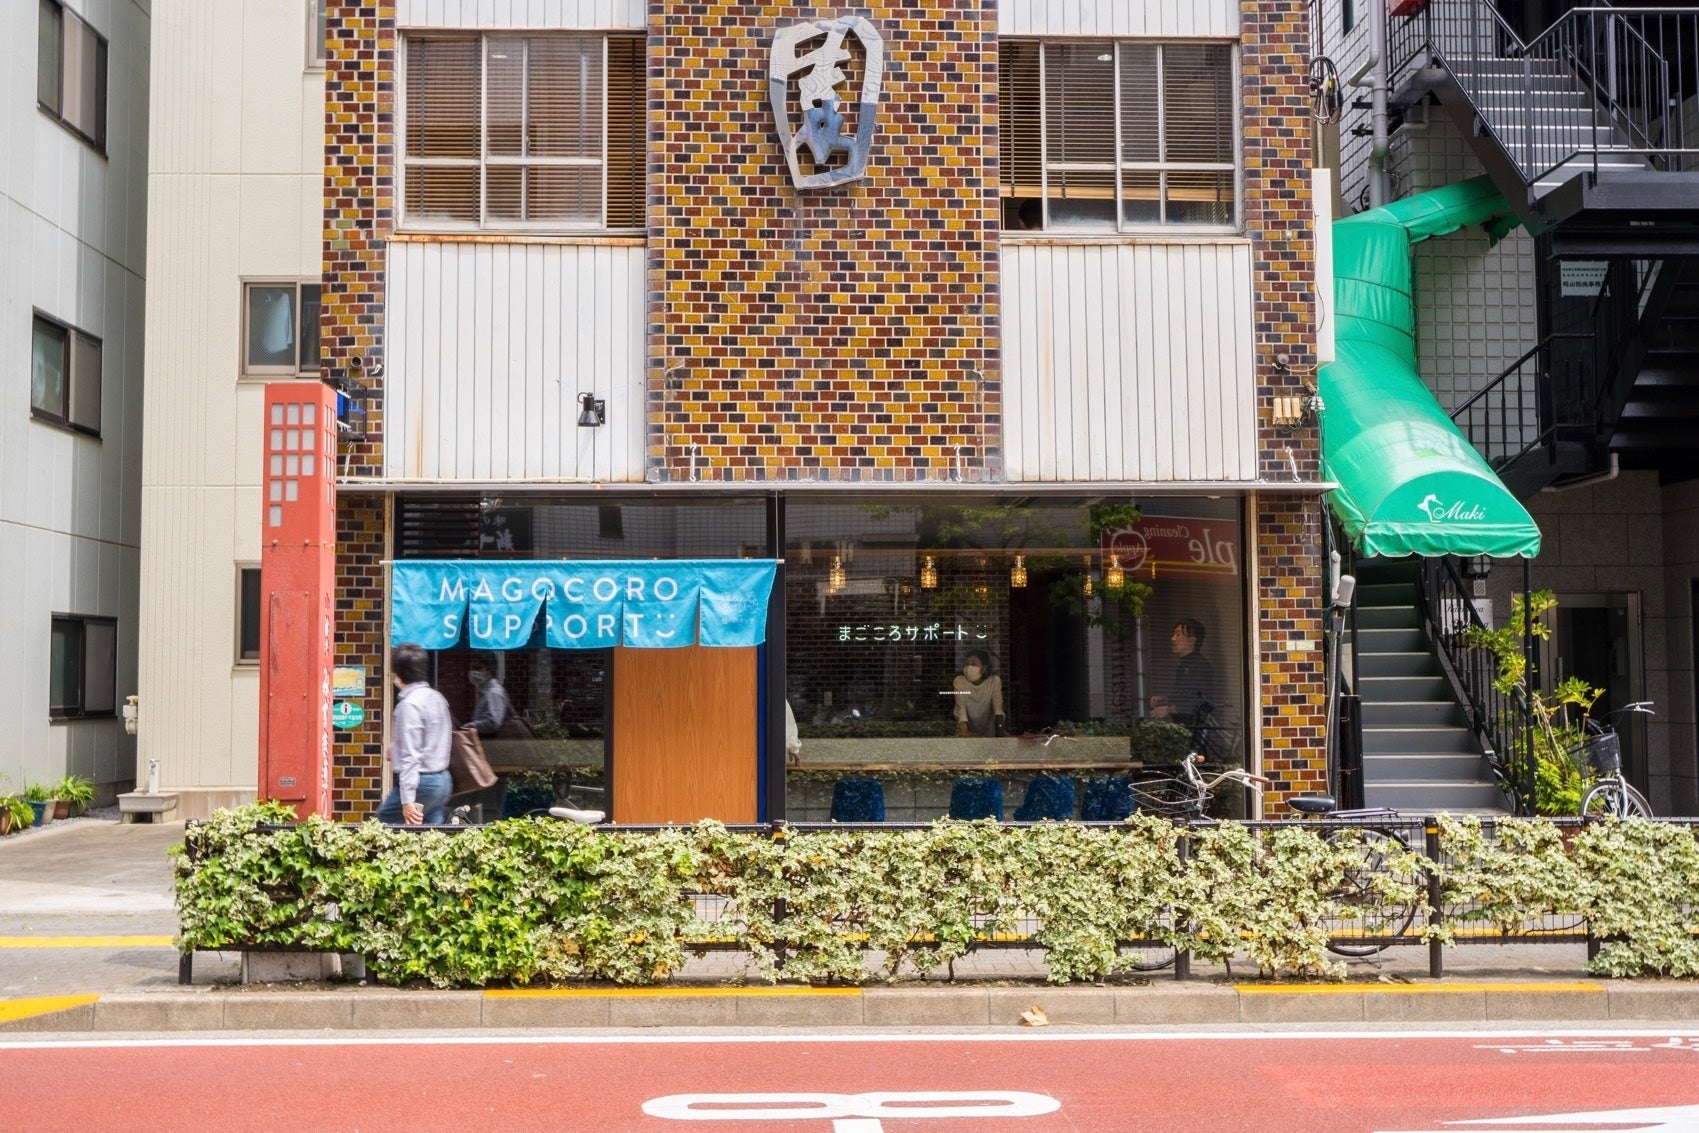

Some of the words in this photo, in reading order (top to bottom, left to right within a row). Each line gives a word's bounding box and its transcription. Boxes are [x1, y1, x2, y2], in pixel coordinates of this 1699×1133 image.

[1433, 500, 1486, 521] Maki
[439, 576, 678, 603] MAGOCORO
[838, 623, 969, 642] まごころサポート
